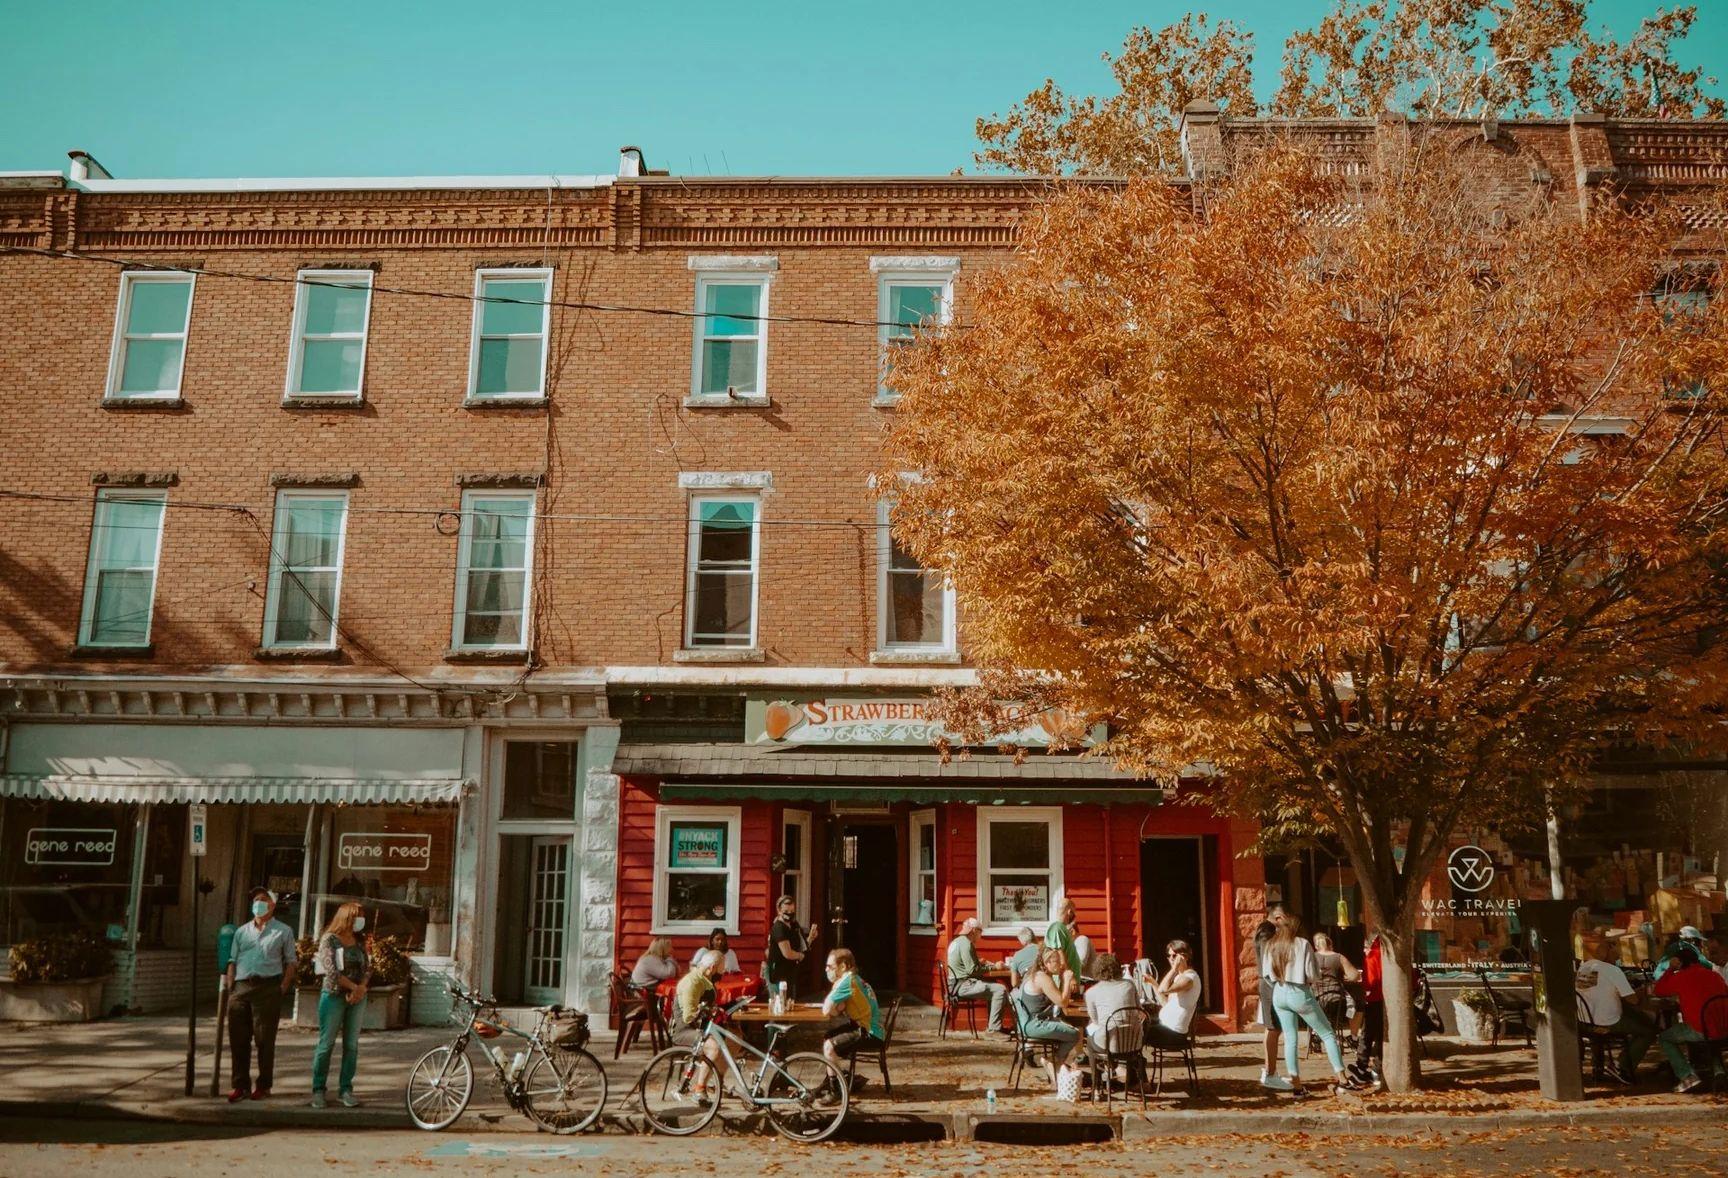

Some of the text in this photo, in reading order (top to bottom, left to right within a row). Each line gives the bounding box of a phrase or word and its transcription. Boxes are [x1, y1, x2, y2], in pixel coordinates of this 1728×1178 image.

[807, 700, 927, 726] STRAWBER
[29, 833, 116, 862] gene reed
[342, 837, 431, 867] gene reed
[678, 840, 719, 851] STRONG
[1421, 899, 1457, 909] WAC
[1471, 961, 1494, 969] ITALY
